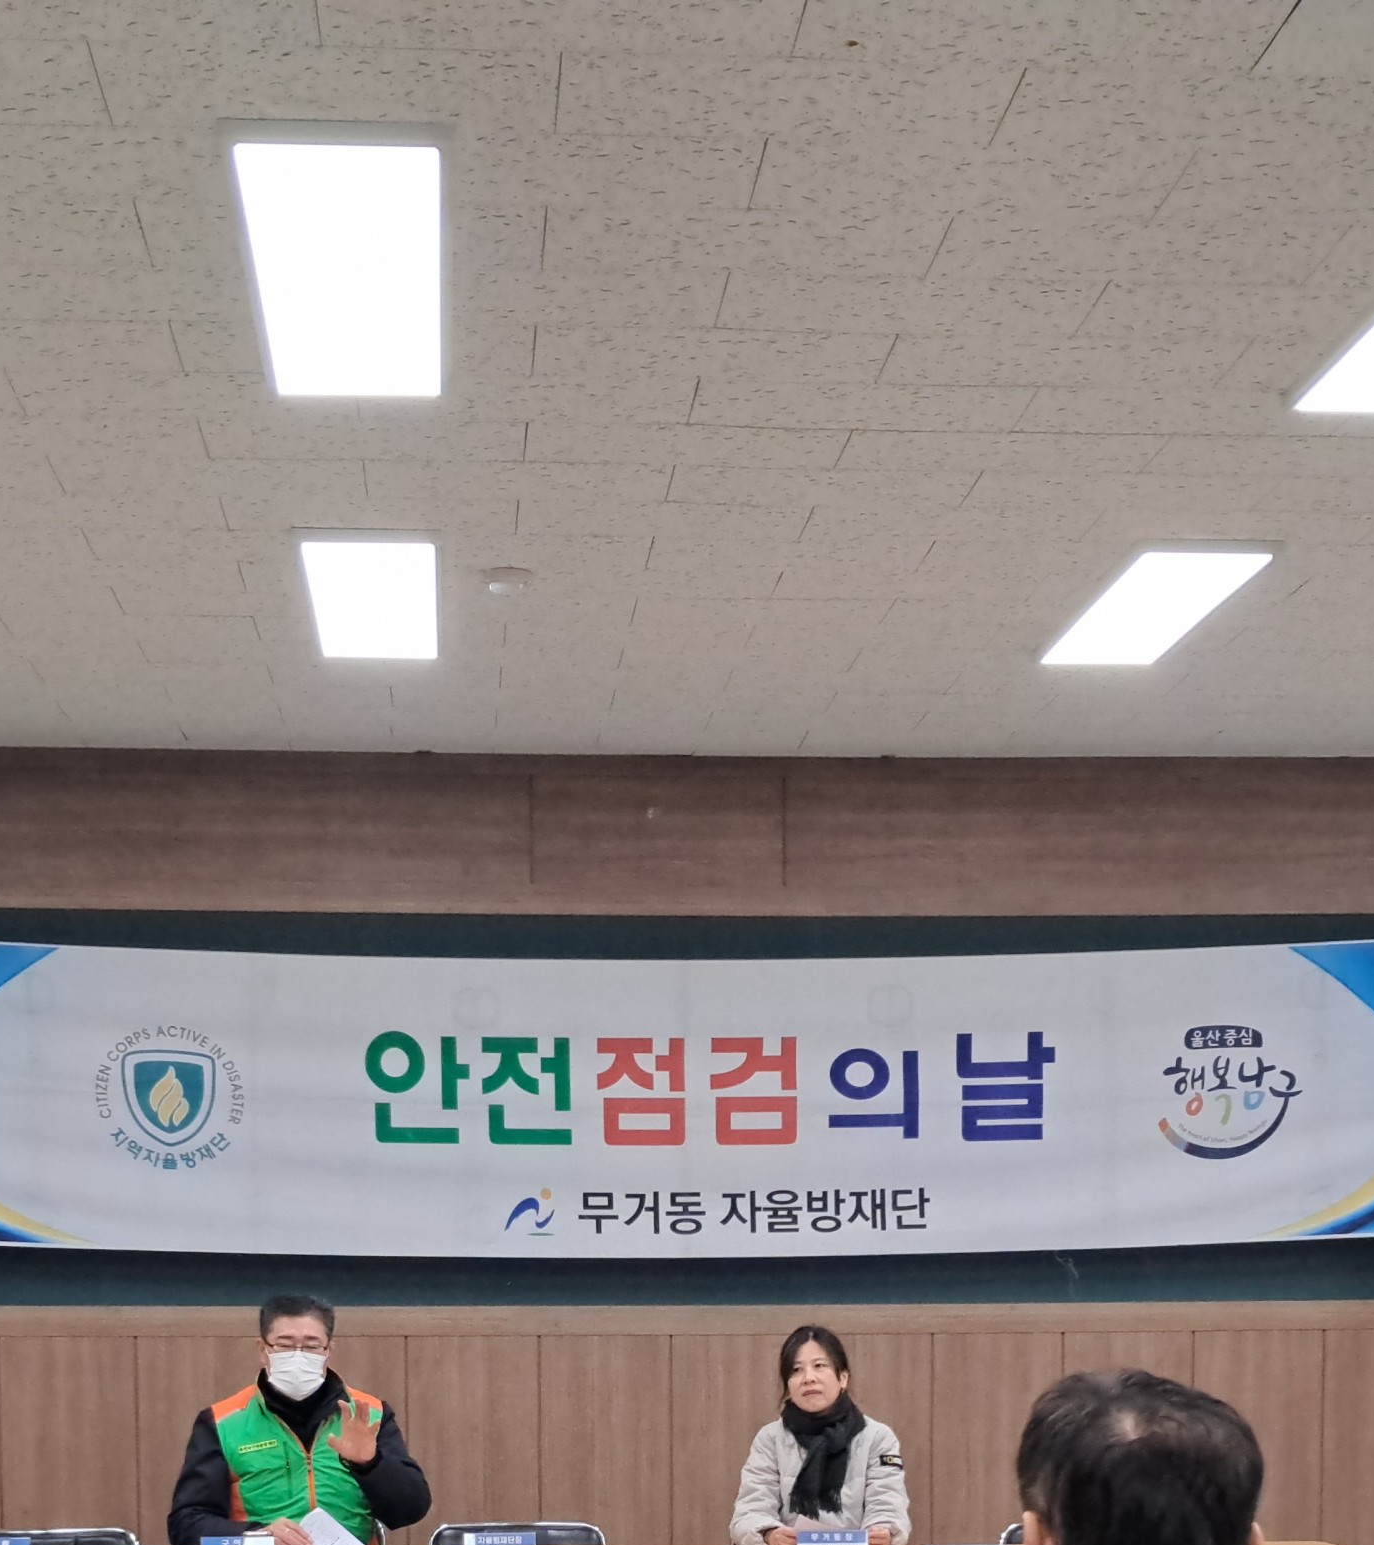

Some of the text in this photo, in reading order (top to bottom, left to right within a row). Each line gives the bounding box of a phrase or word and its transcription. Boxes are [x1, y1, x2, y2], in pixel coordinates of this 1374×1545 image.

[95, 1025, 245, 1125] CITIZEN CORPS ACTIVE IN DISASTER
[110, 1127, 231, 1170] 지역자율방재단
[578, 1187, 930, 1235] 무거동 자율방재단
